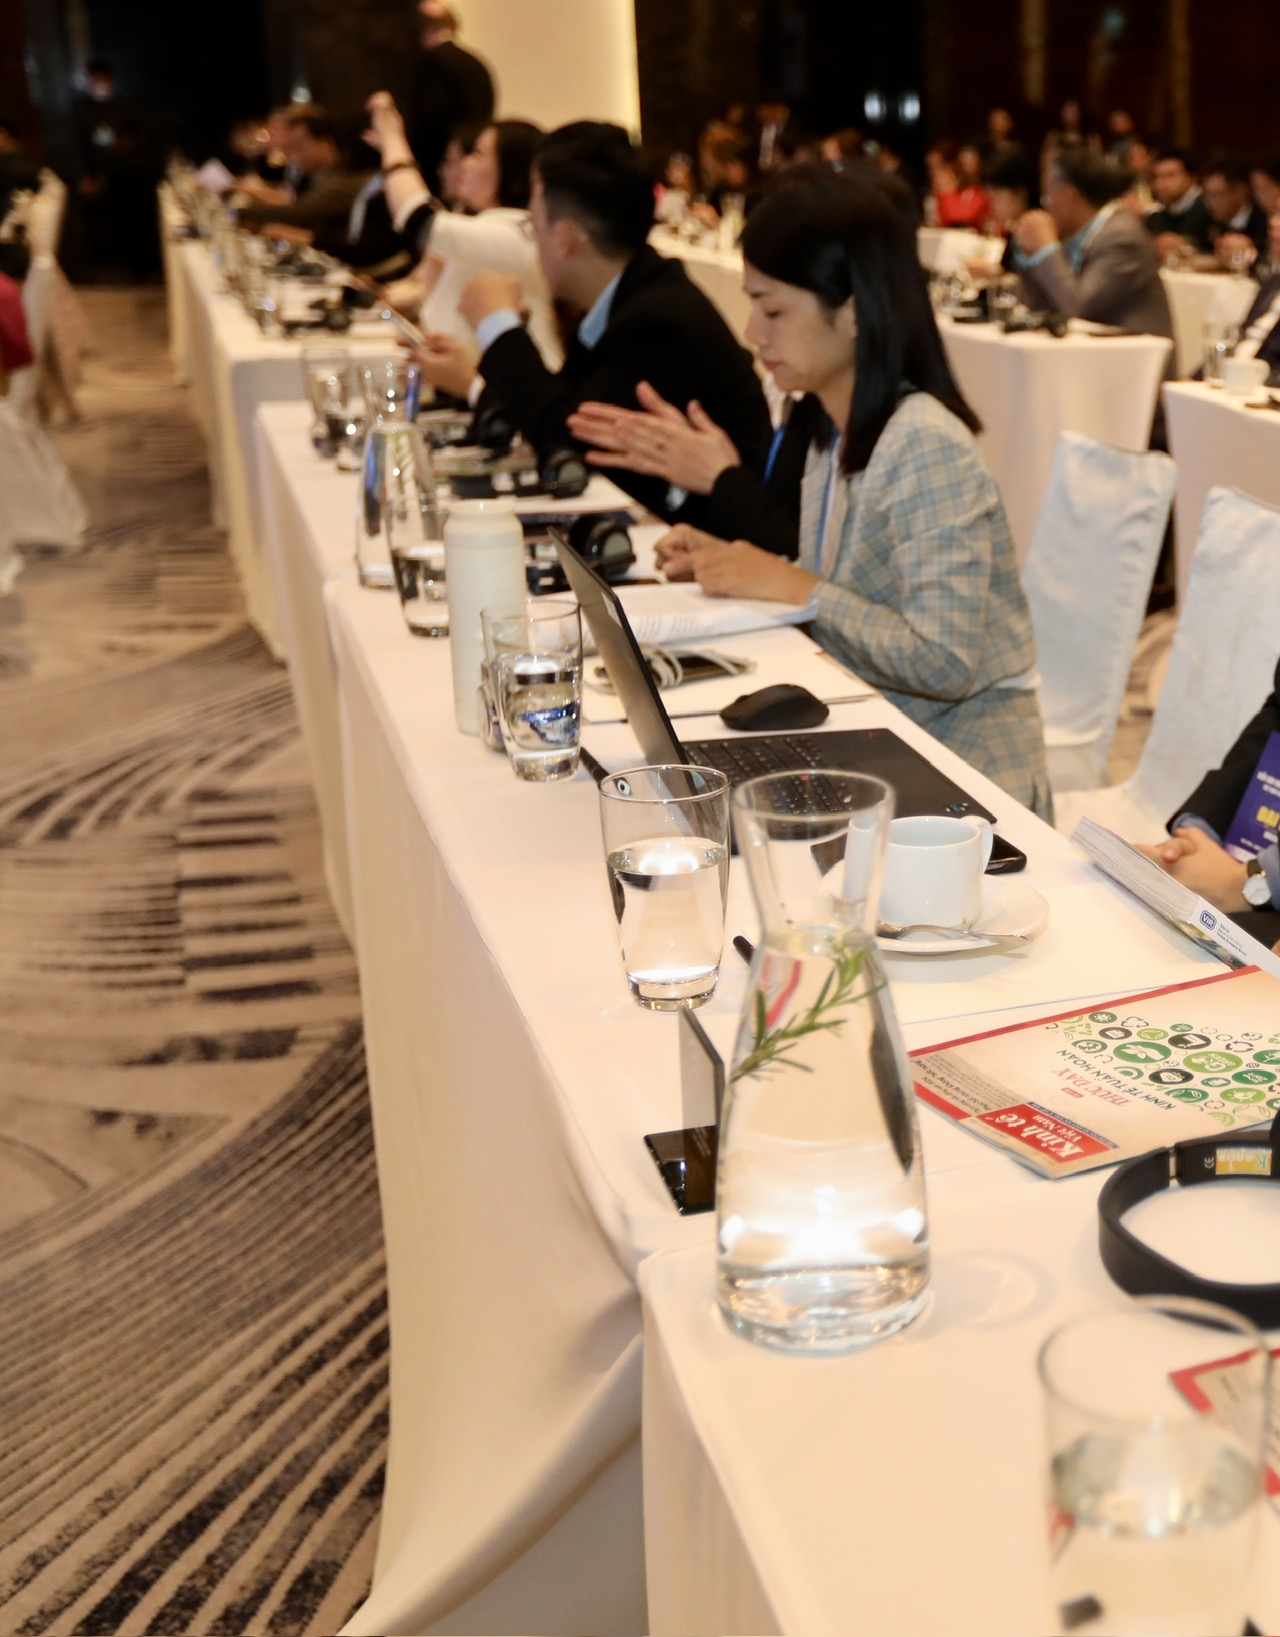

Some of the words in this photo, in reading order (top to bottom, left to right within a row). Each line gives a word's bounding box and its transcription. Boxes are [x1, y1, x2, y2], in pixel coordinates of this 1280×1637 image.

[1056, 1049, 1096, 1071] HOÀN
[1140, 1094, 1176, 1110] KINH
[985, 1113, 1027, 1128] tế
[1032, 1114, 1061, 1130] Nam
[1020, 1125, 1084, 1158] Kinh
[1057, 1128, 1082, 1143] Việt
